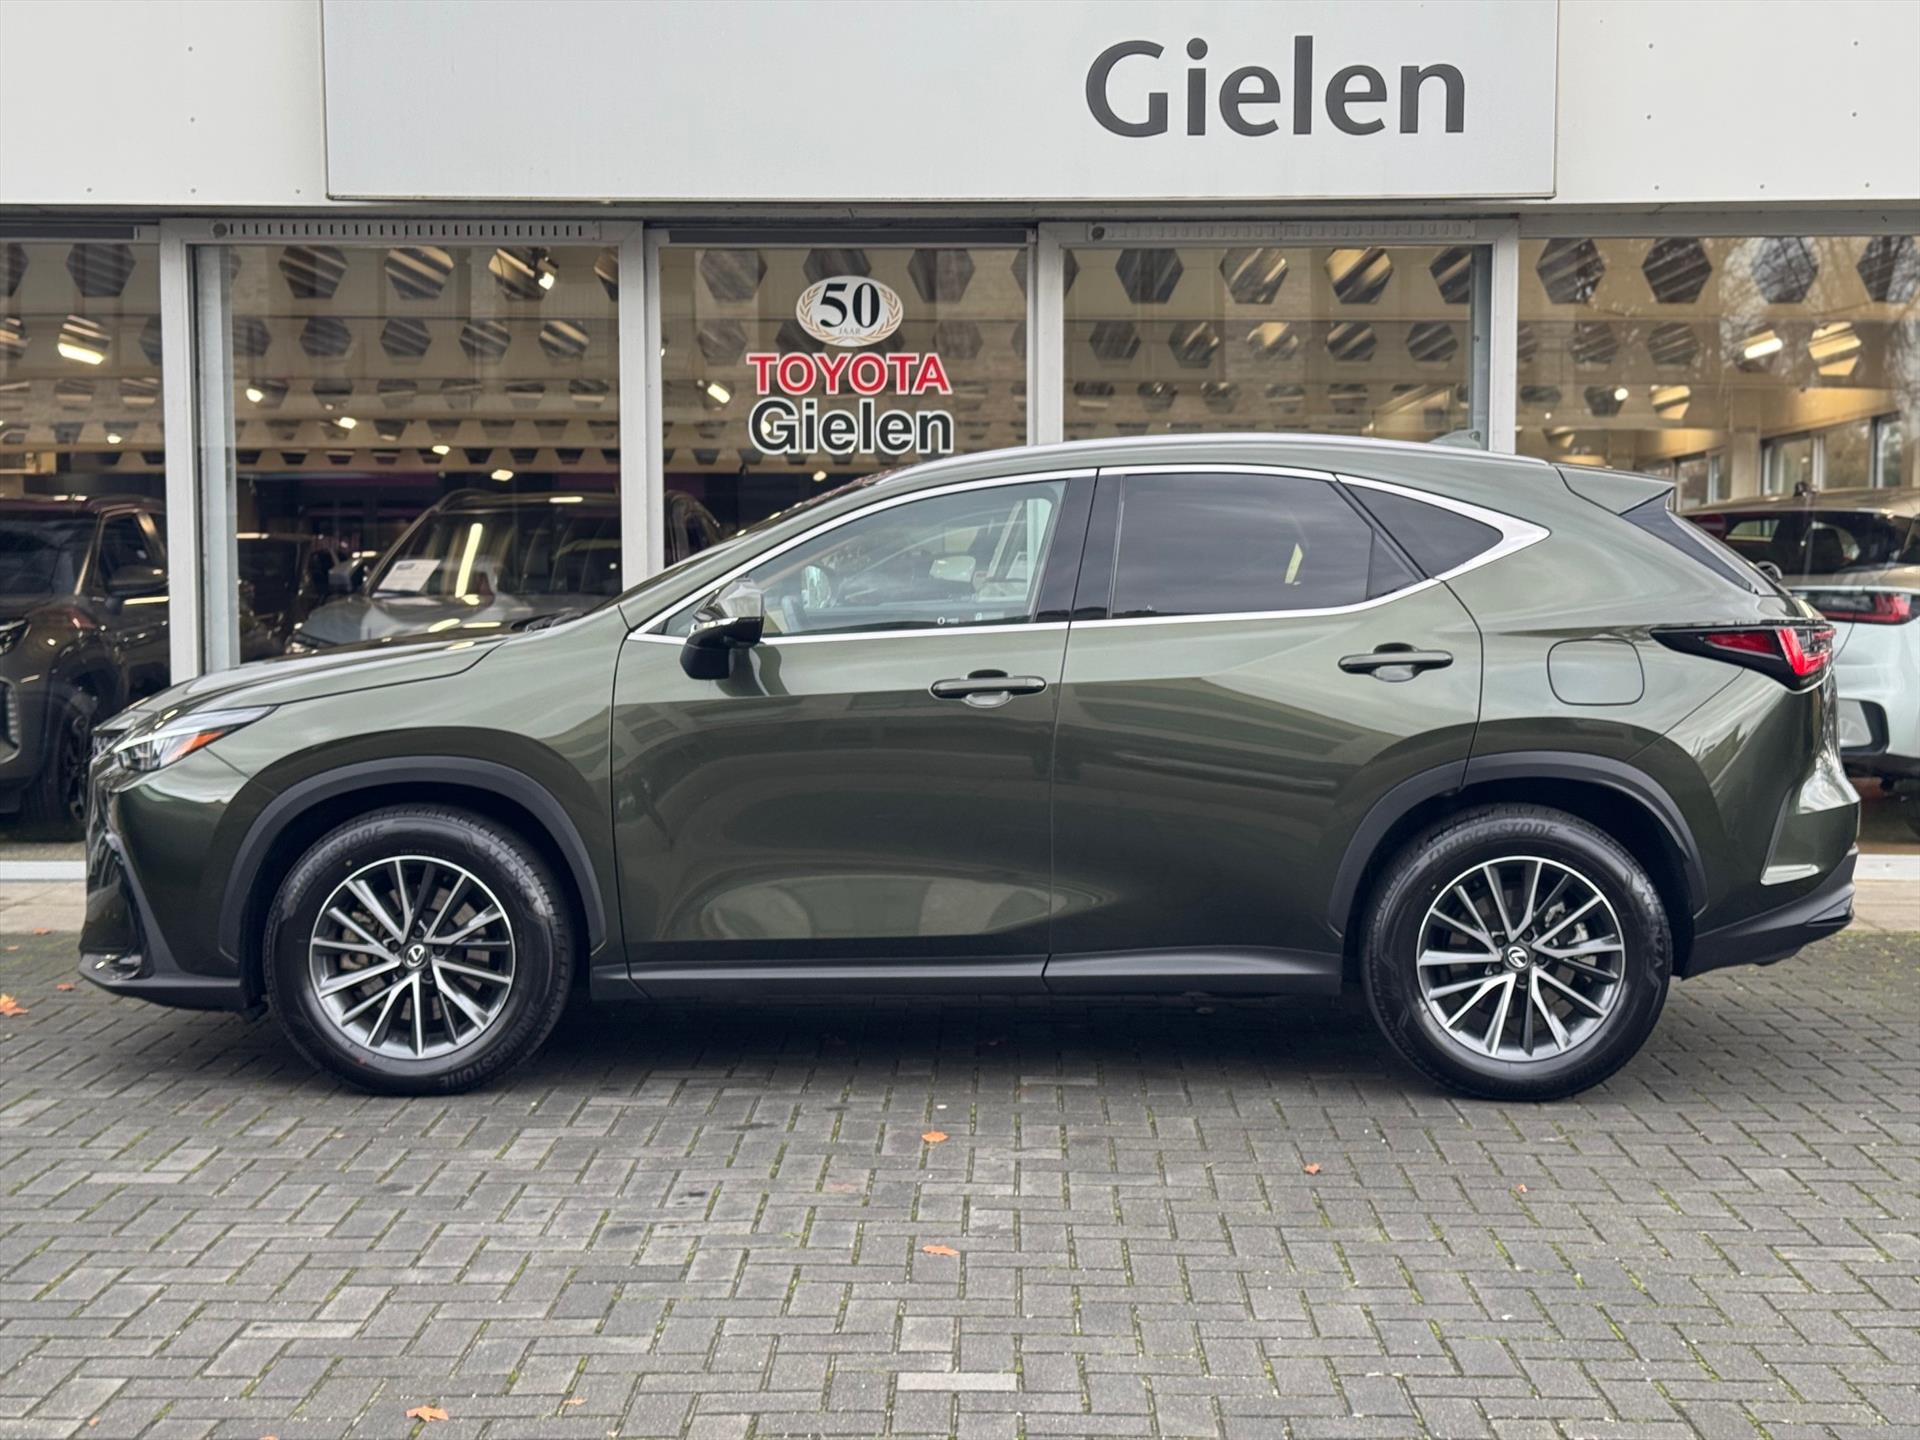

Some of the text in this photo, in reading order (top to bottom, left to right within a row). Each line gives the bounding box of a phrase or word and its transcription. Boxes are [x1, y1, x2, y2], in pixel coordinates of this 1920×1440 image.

[1085, 35, 1465, 138] Gielen
[819, 282, 881, 329] 50
[746, 352, 953, 395] TOYOTA
[749, 397, 954, 455] Gielen
